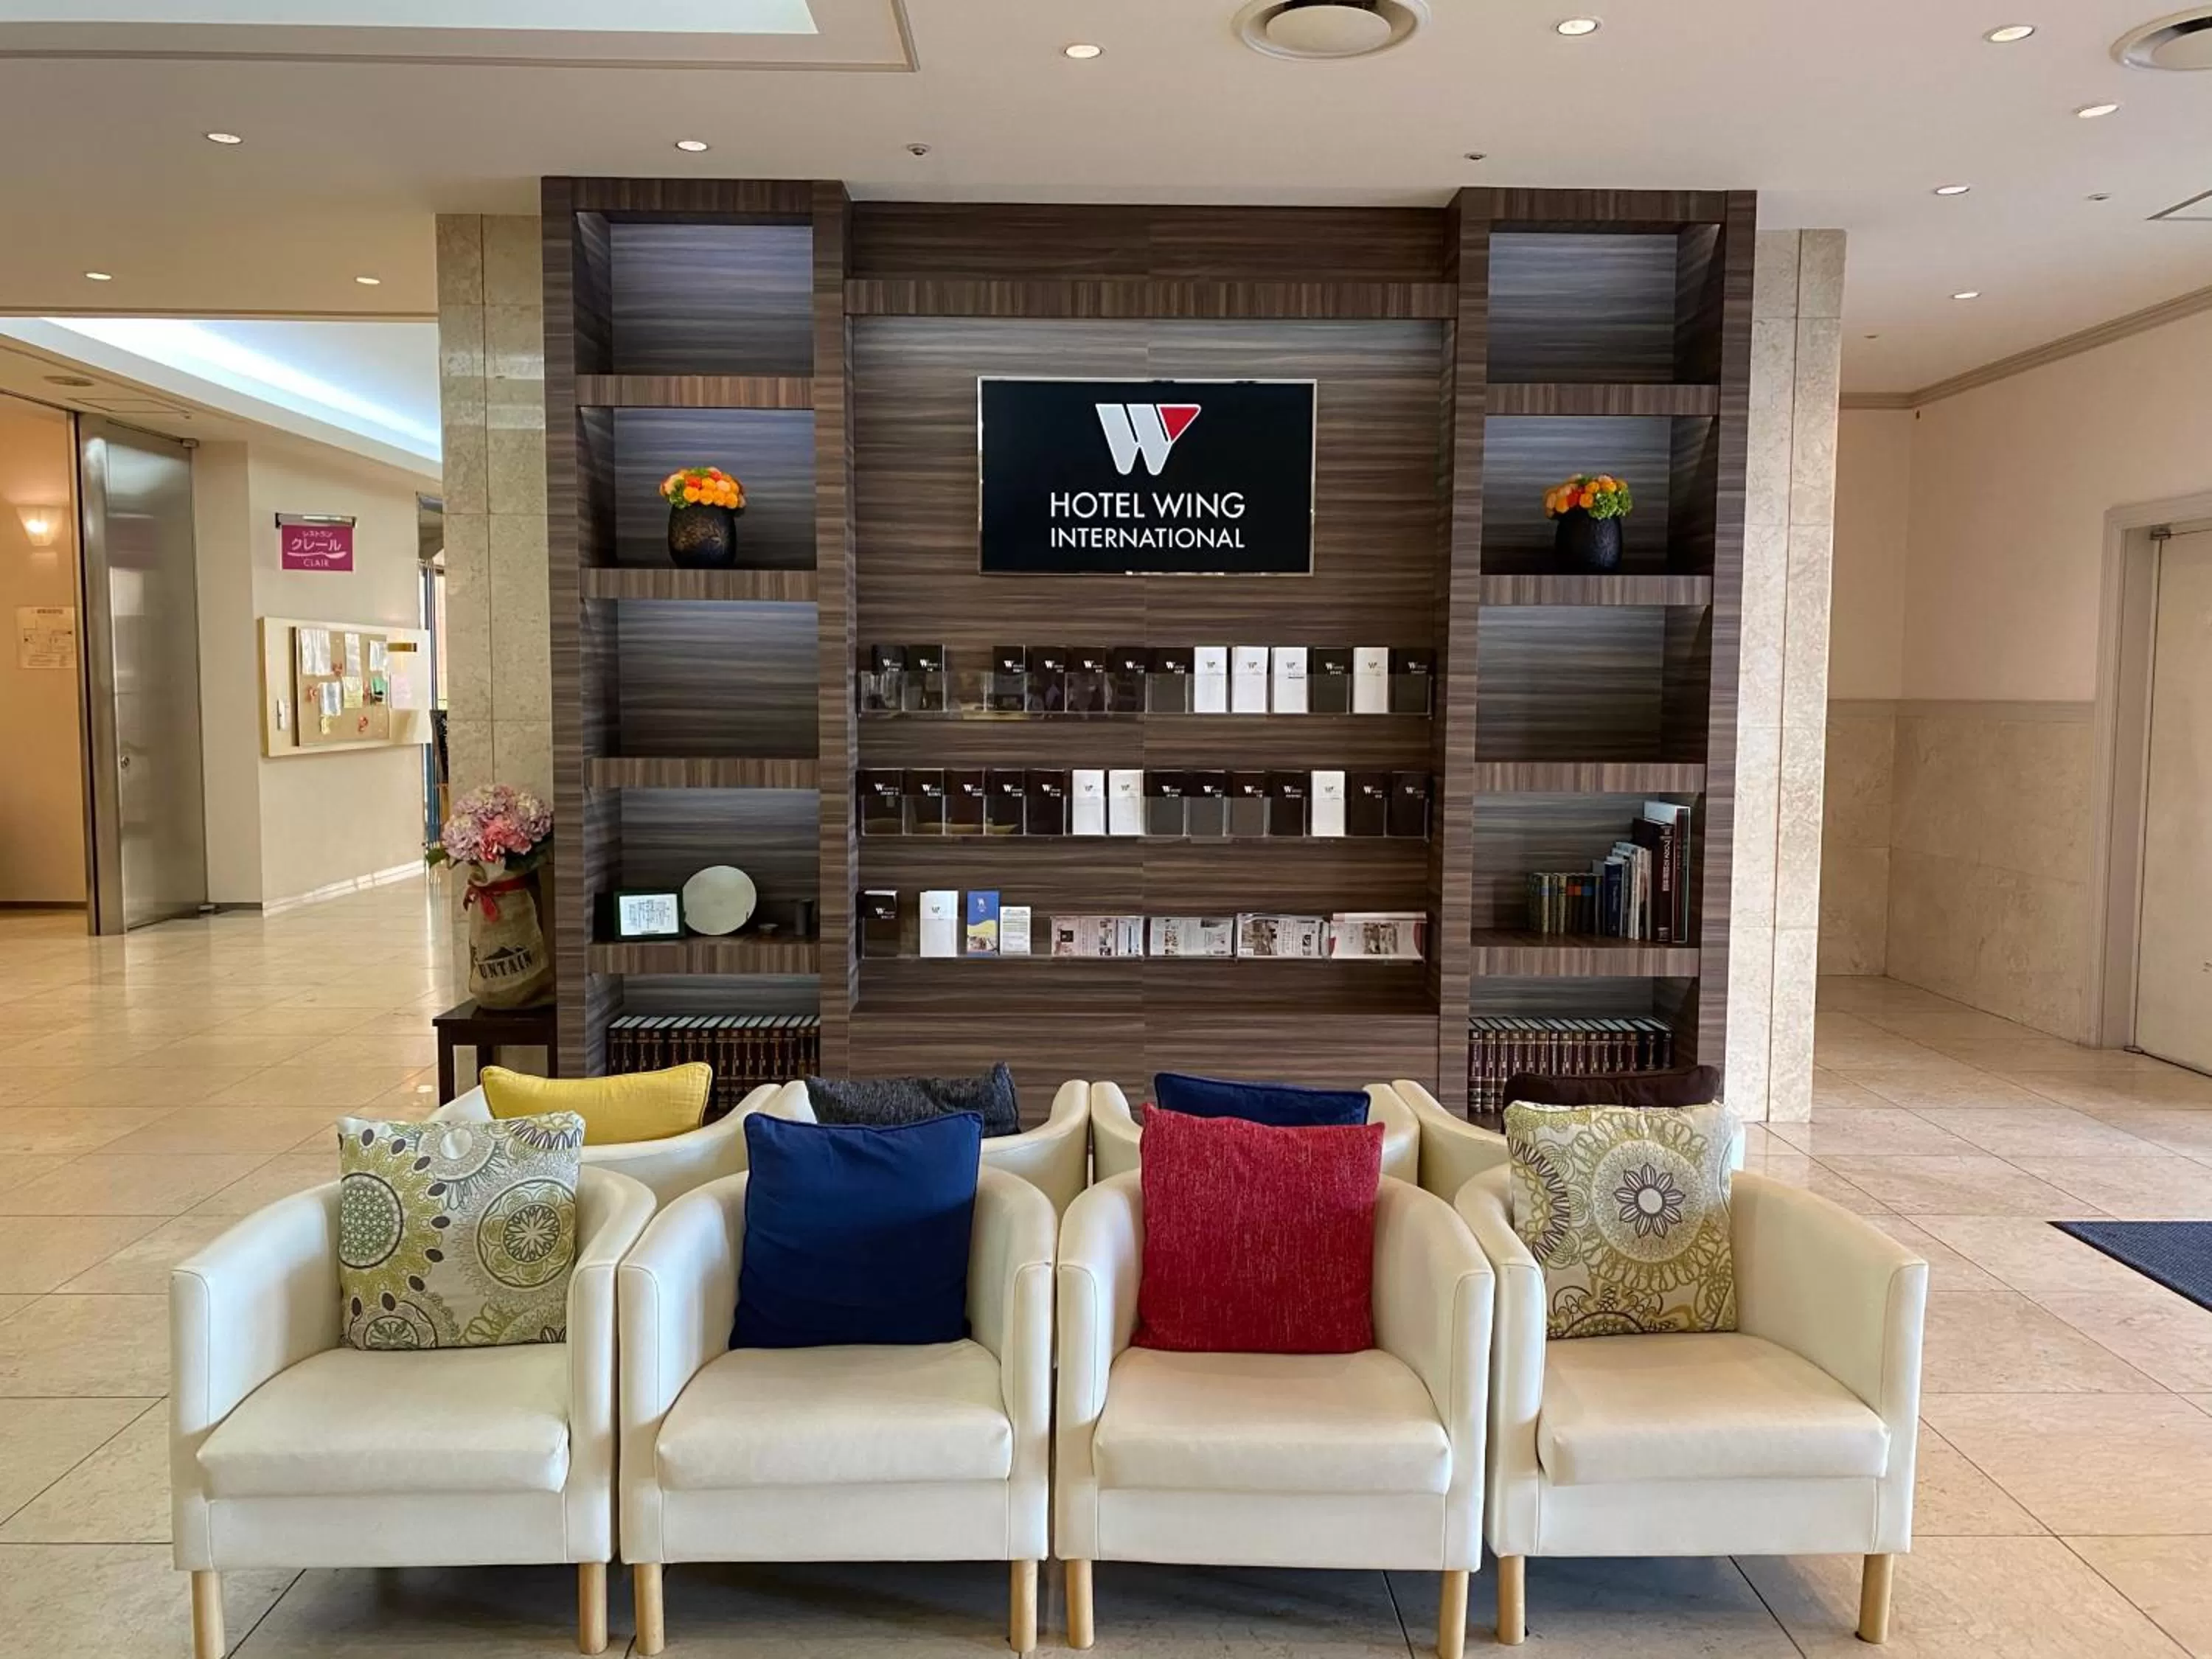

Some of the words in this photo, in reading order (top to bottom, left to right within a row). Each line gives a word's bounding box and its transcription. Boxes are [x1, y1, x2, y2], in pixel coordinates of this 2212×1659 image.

[1051, 492, 1145, 518] HOTEL
[1152, 492, 1245, 518] WING
[291, 538, 342, 552] クレール
[1051, 527, 1245, 548] INTERNATIONAL
[303, 558, 330, 567] CLAIR
